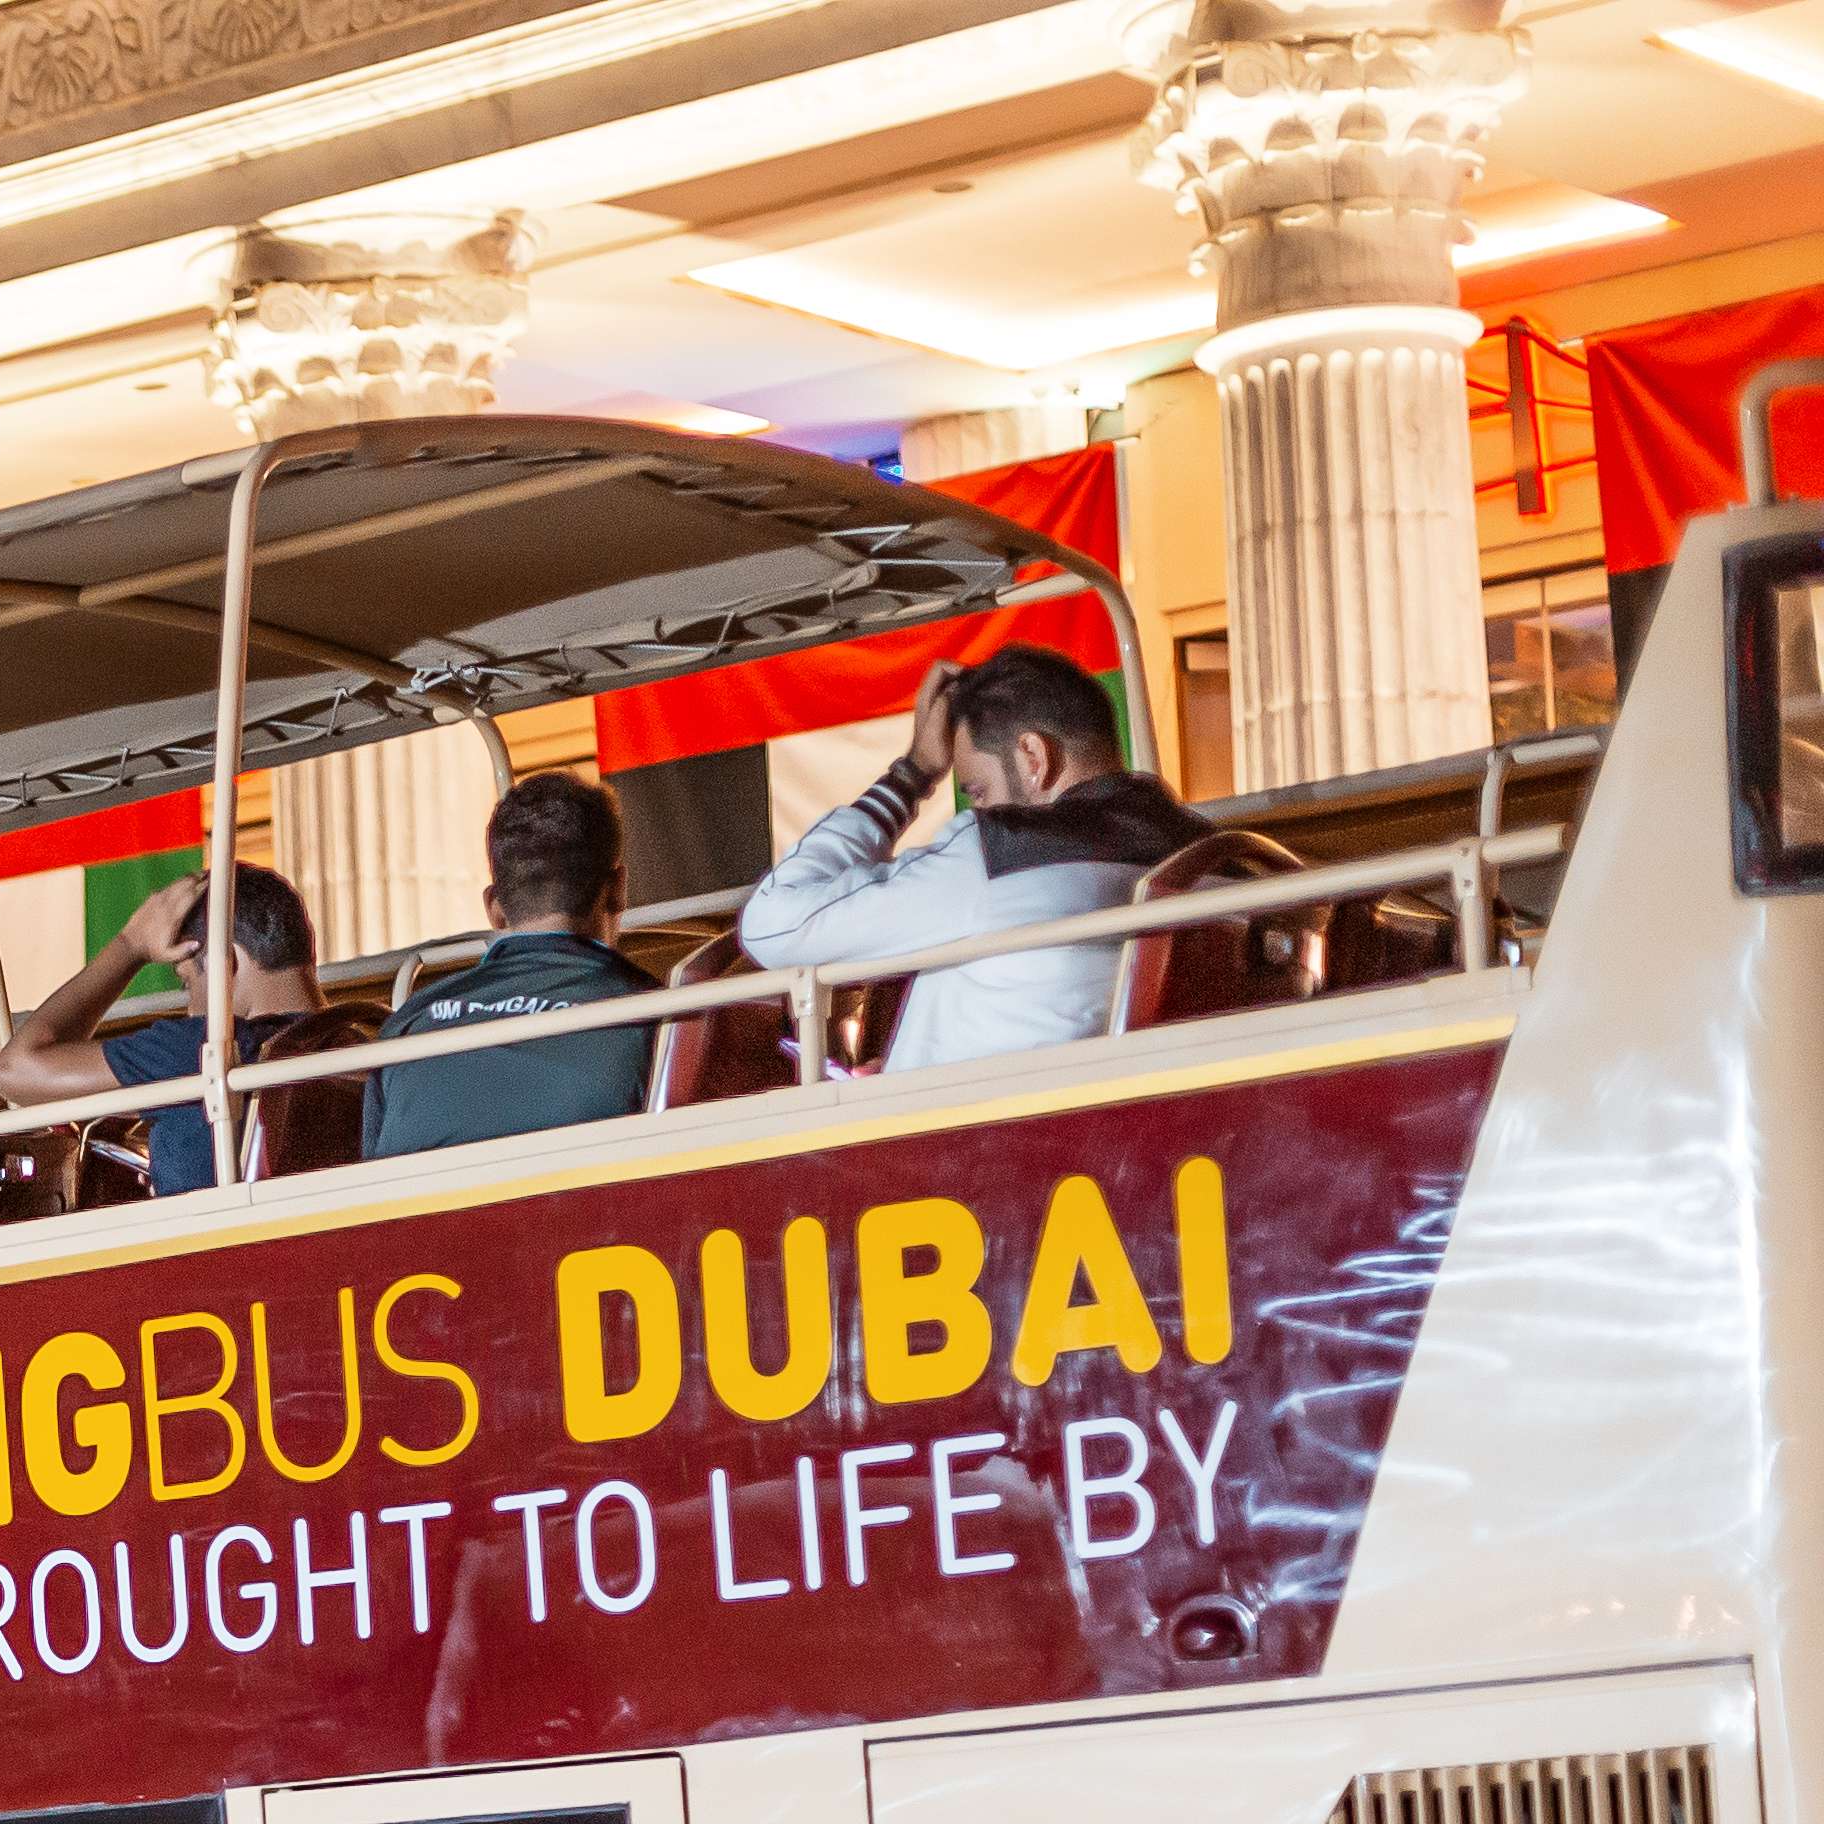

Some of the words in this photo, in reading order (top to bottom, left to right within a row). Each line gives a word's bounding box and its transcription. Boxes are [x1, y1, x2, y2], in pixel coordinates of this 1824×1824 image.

[555, 1156, 1234, 1444] DUBAI
[493, 1480, 658, 1622] TO
[710, 1432, 1016, 1603] LIFE
[1060, 1400, 1238, 1562] BY
